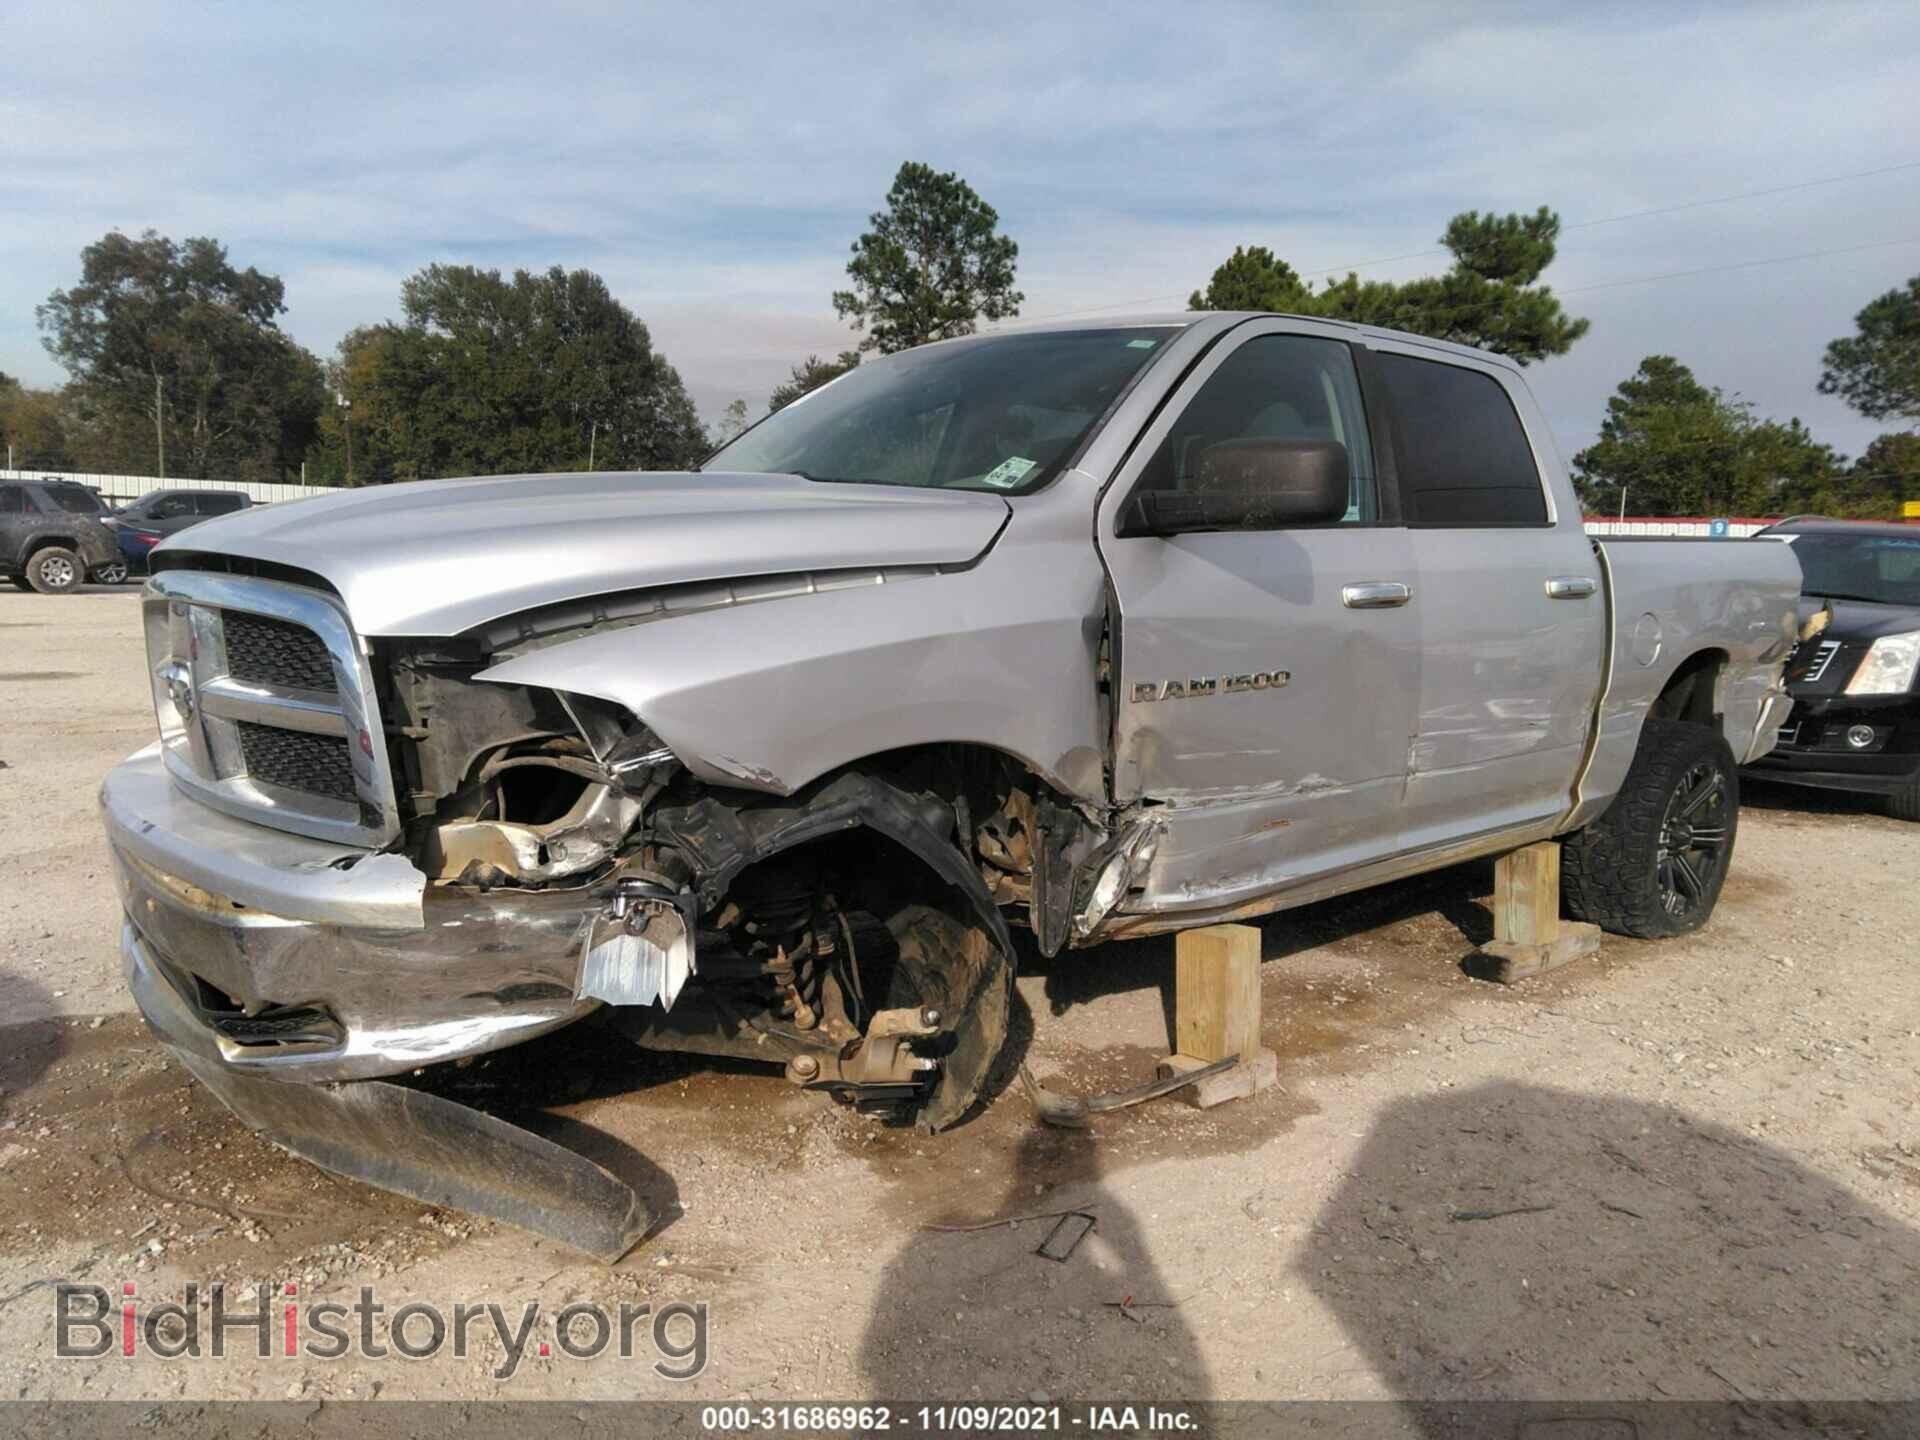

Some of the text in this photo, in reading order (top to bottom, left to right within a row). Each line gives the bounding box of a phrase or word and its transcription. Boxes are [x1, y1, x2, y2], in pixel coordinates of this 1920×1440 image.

[1715, 521, 1724, 534] 9
[1131, 670, 1291, 702] RAM 1500
